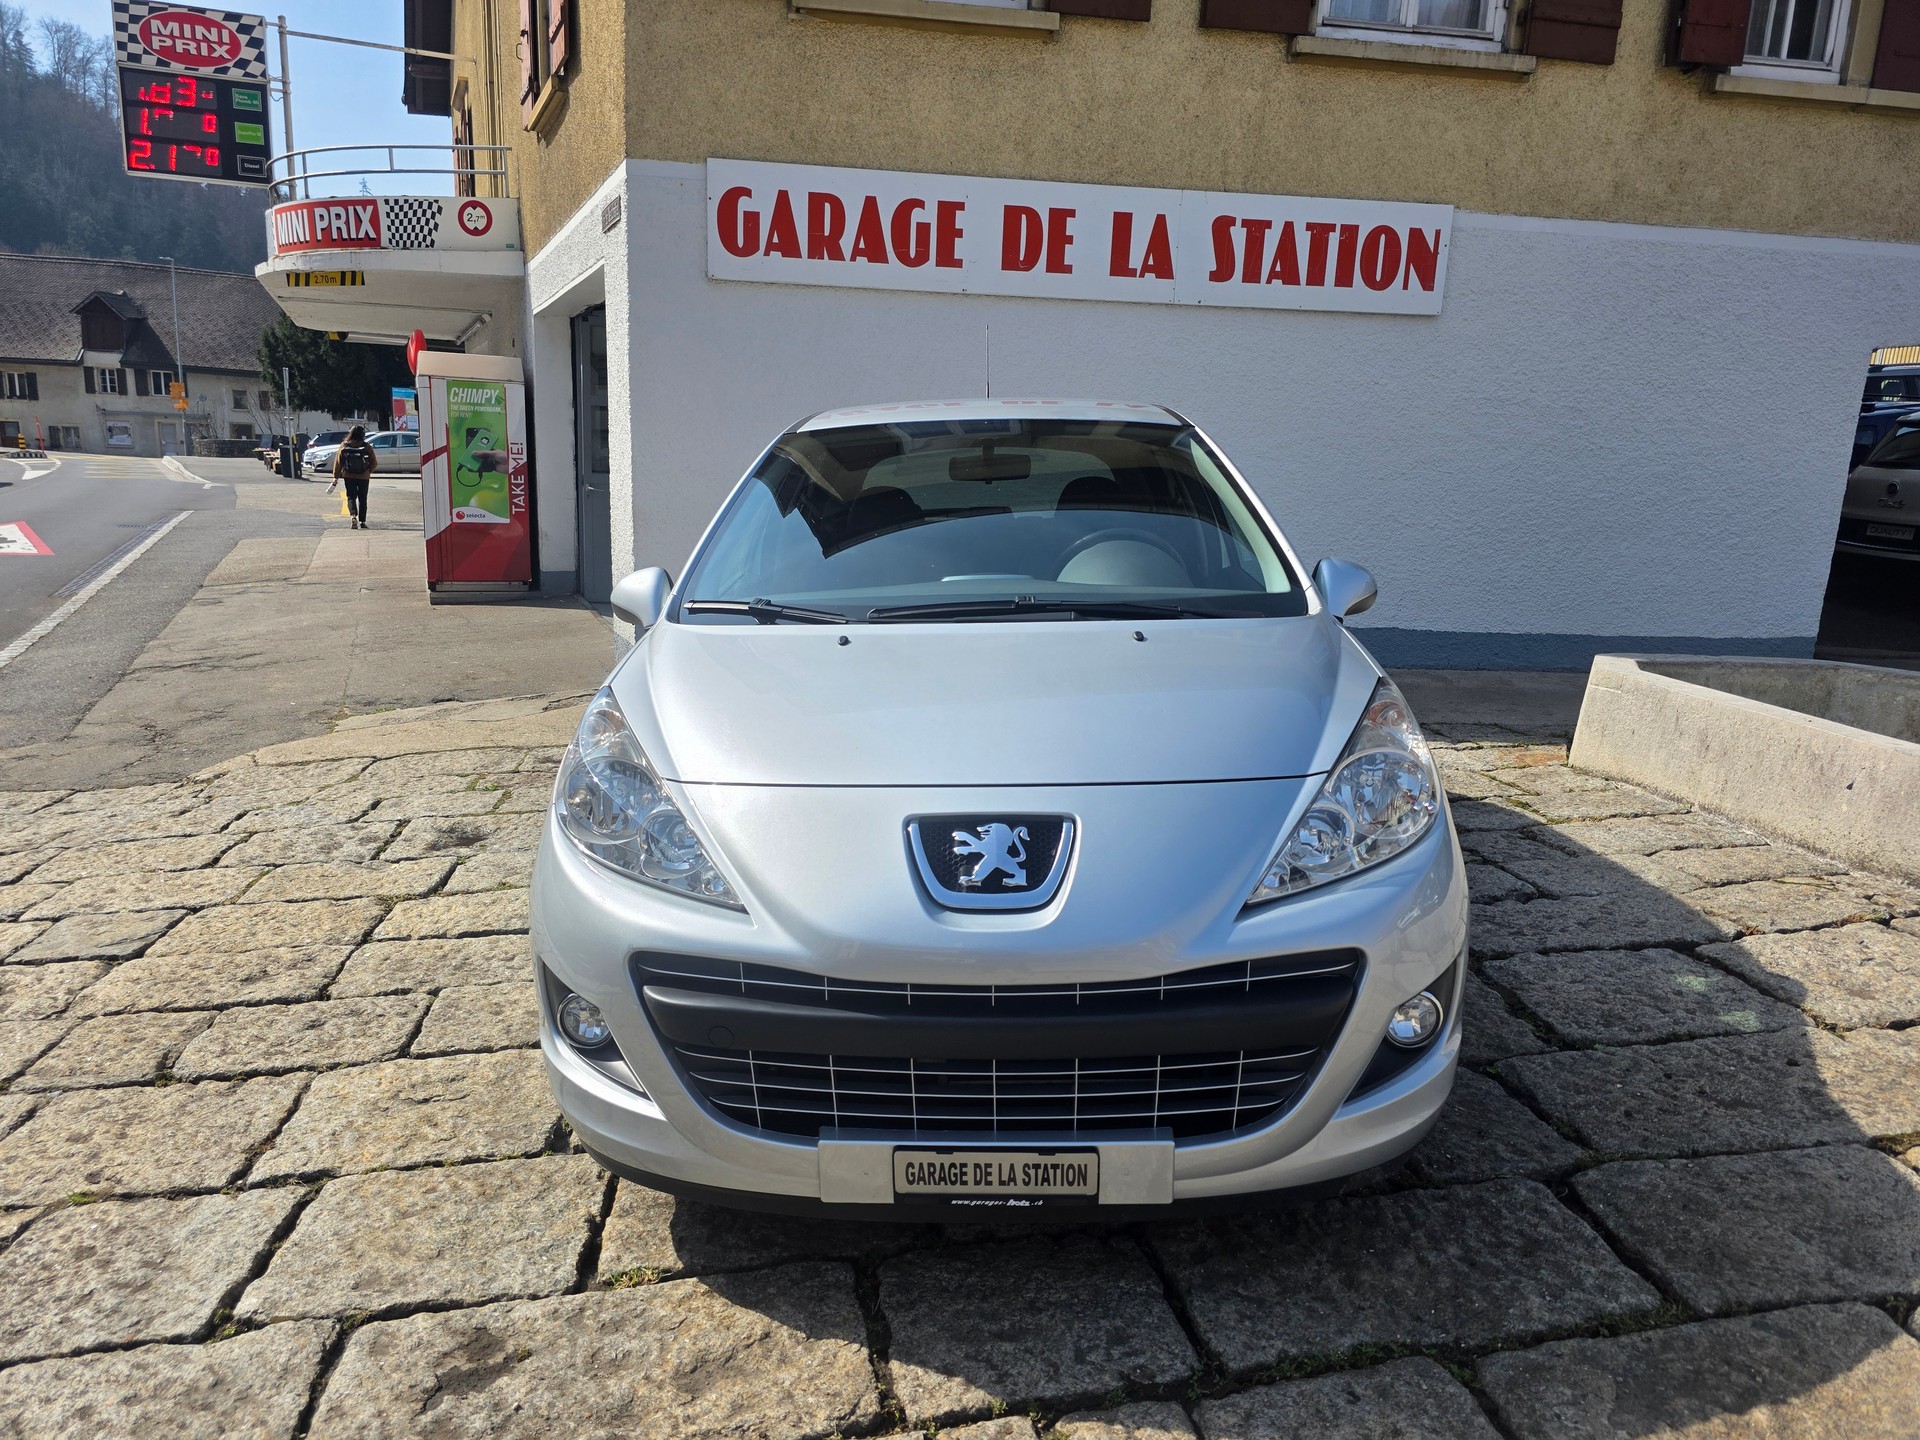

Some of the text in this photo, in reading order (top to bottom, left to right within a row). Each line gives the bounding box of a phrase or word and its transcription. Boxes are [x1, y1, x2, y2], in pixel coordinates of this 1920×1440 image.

[150, 19, 231, 44] MINI
[151, 35, 232, 60] PRIX
[244, 162, 260, 170] Diesel
[276, 205, 378, 247] MINI PRIX
[716, 185, 1442, 293] GARAGE DE LA STATION
[313, 275, 338, 284] 2.70m
[450, 387, 500, 405] CHIMPY
[510, 442, 526, 515] TAKE ME!
[905, 1162, 1088, 1188] GARAGE DE LA STATION
